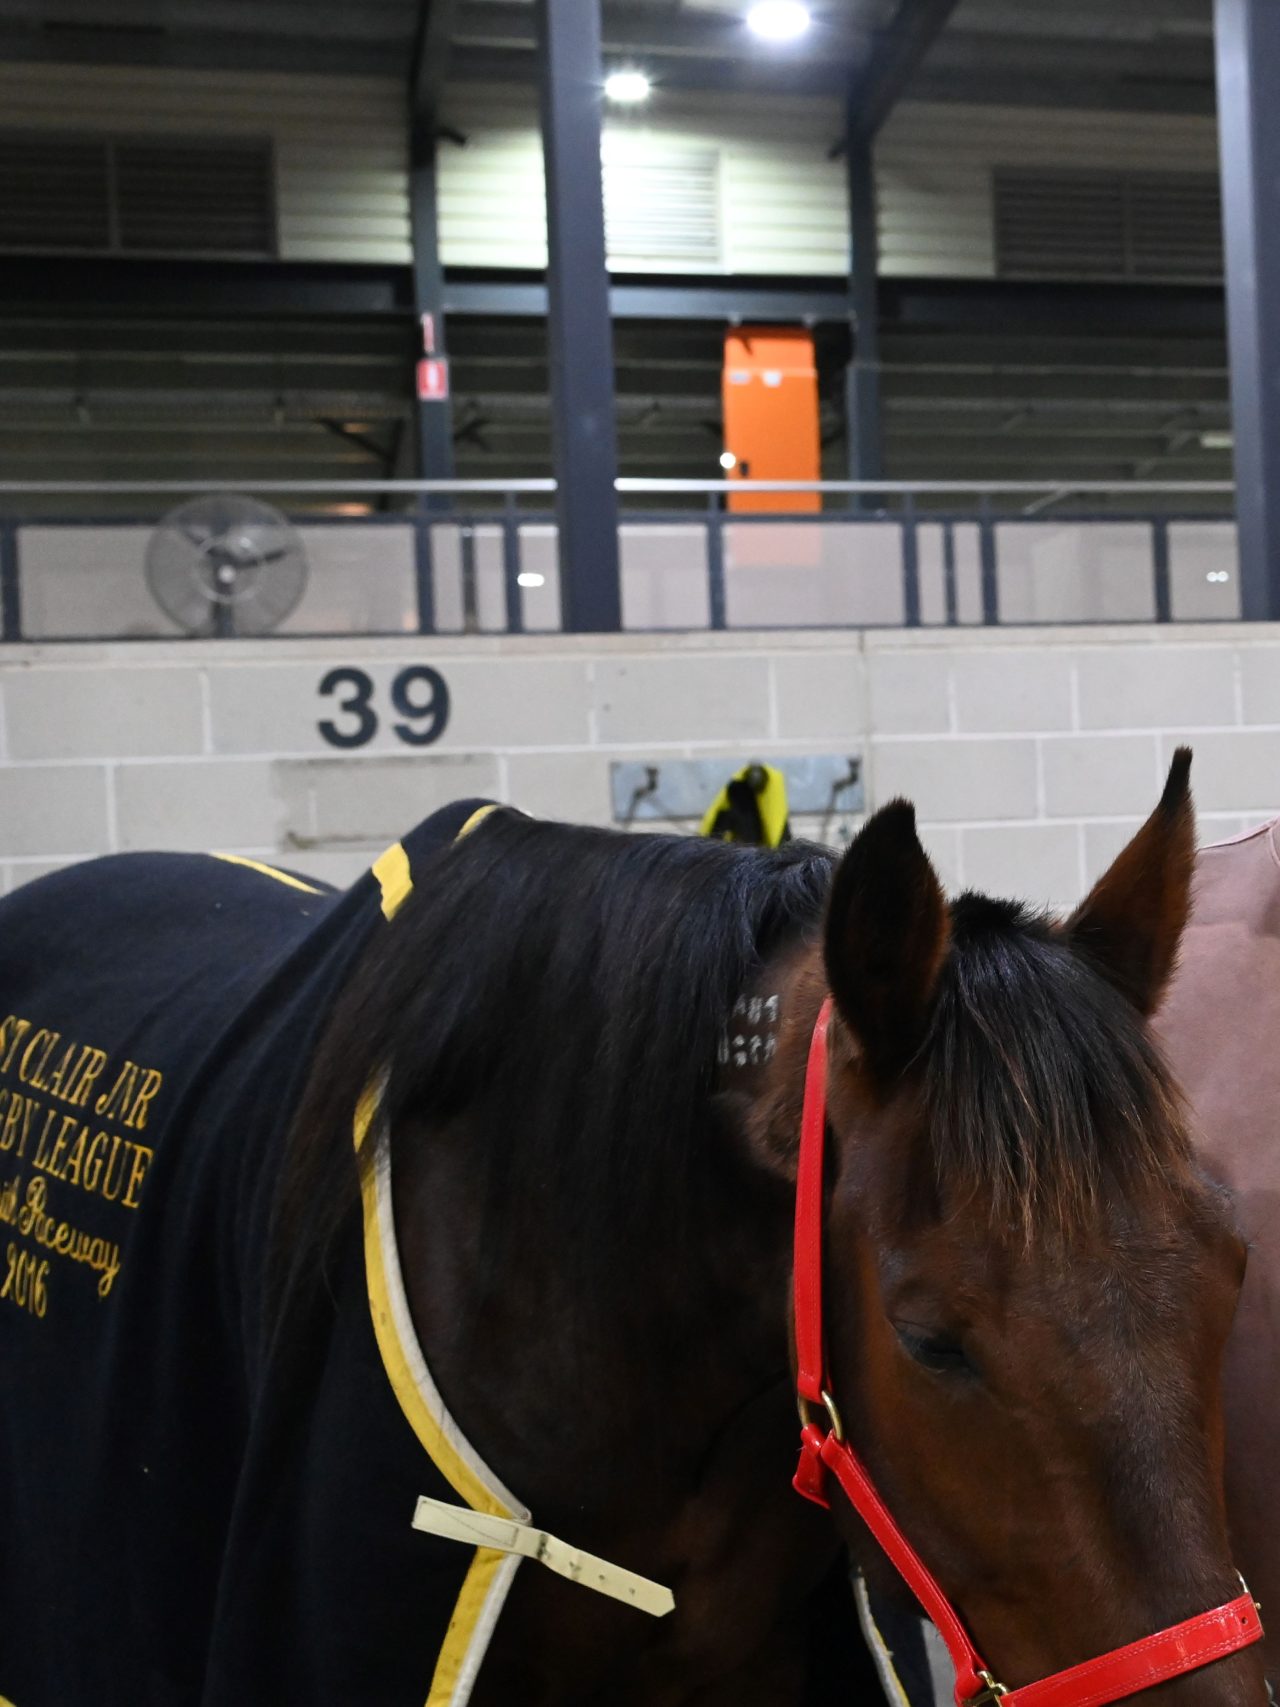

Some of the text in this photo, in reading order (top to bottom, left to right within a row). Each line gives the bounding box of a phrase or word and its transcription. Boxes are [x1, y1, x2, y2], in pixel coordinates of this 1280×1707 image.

[317, 665, 451, 749] 39
[19, 1028, 107, 1105] CLAIR
[95, 1060, 163, 1129] JNR
[32, 1109, 154, 1208] LEAGUE
